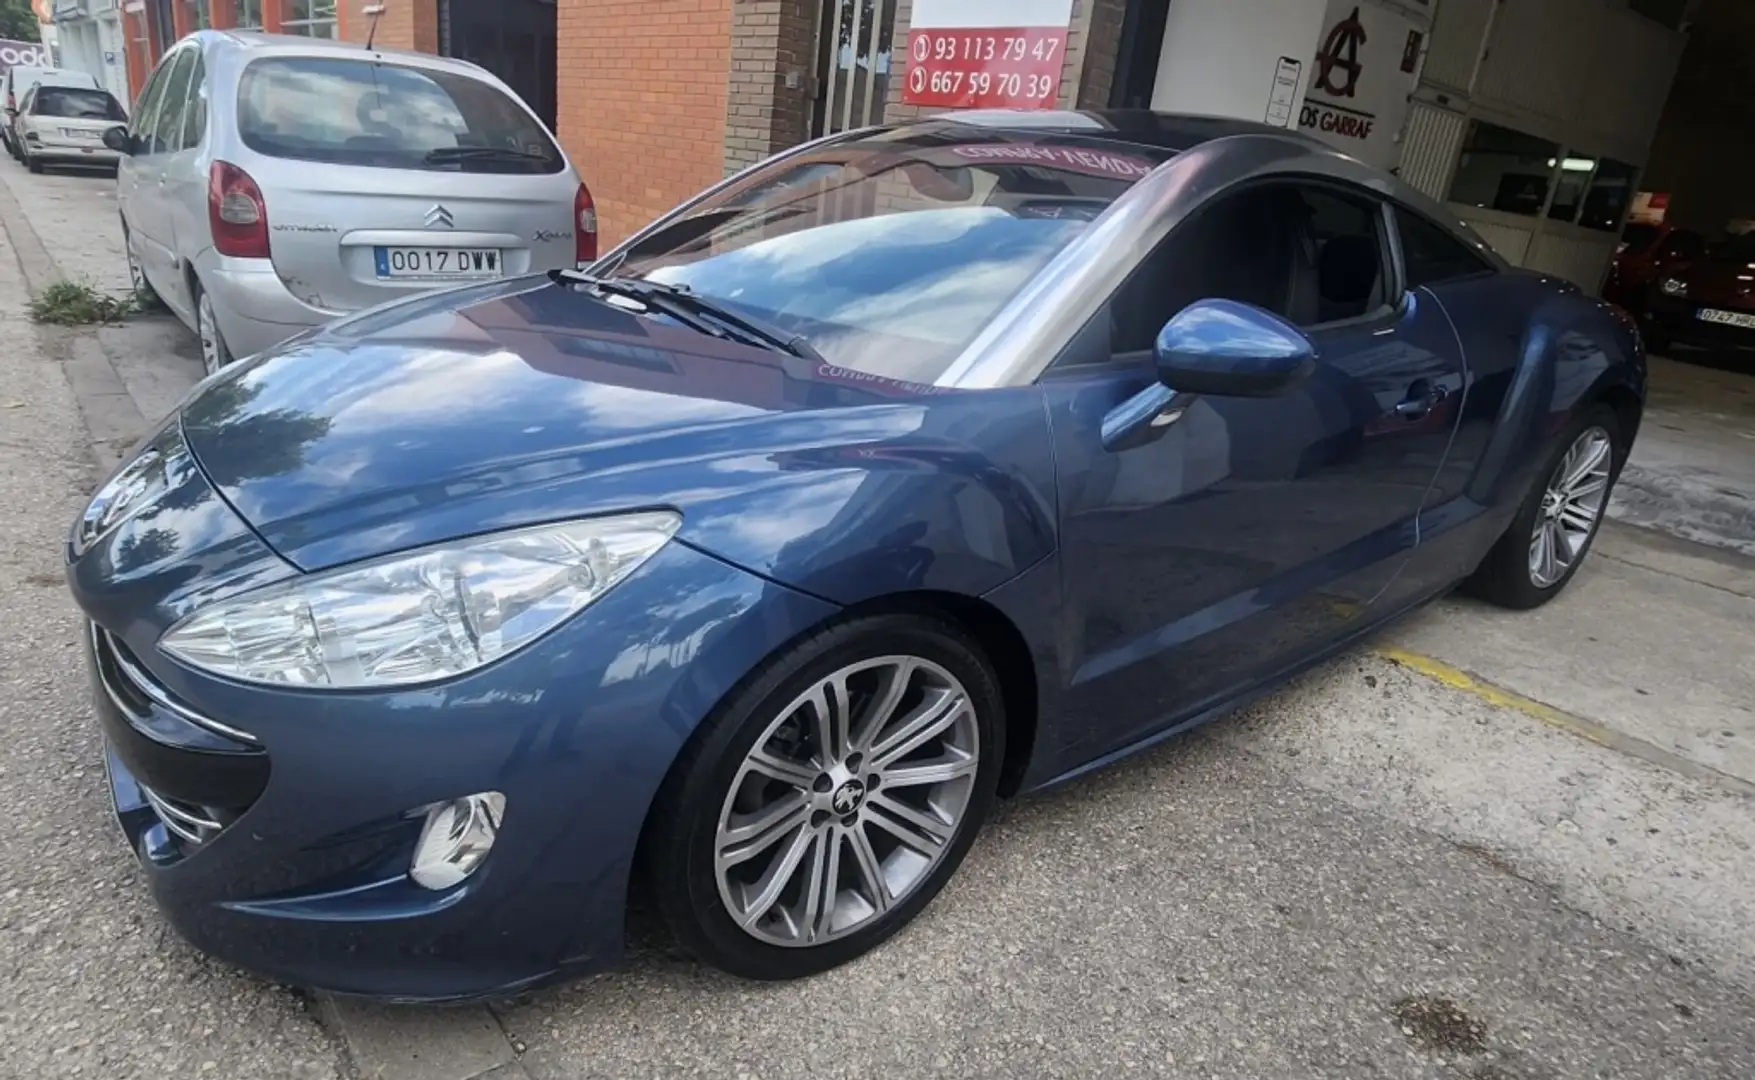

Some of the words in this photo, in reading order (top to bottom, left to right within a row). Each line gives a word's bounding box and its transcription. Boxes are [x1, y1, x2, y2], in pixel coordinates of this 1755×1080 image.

[935, 37, 956, 60] 93
[963, 38, 995, 60] 113
[1002, 38, 1026, 61] 79
[1032, 38, 1059, 62] 47
[931, 71, 964, 94] 667
[968, 72, 990, 95] 59
[997, 73, 1021, 97] 70
[1026, 75, 1052, 98] 39
[392, 250, 448, 271] 0017
[458, 251, 497, 271] DWW
